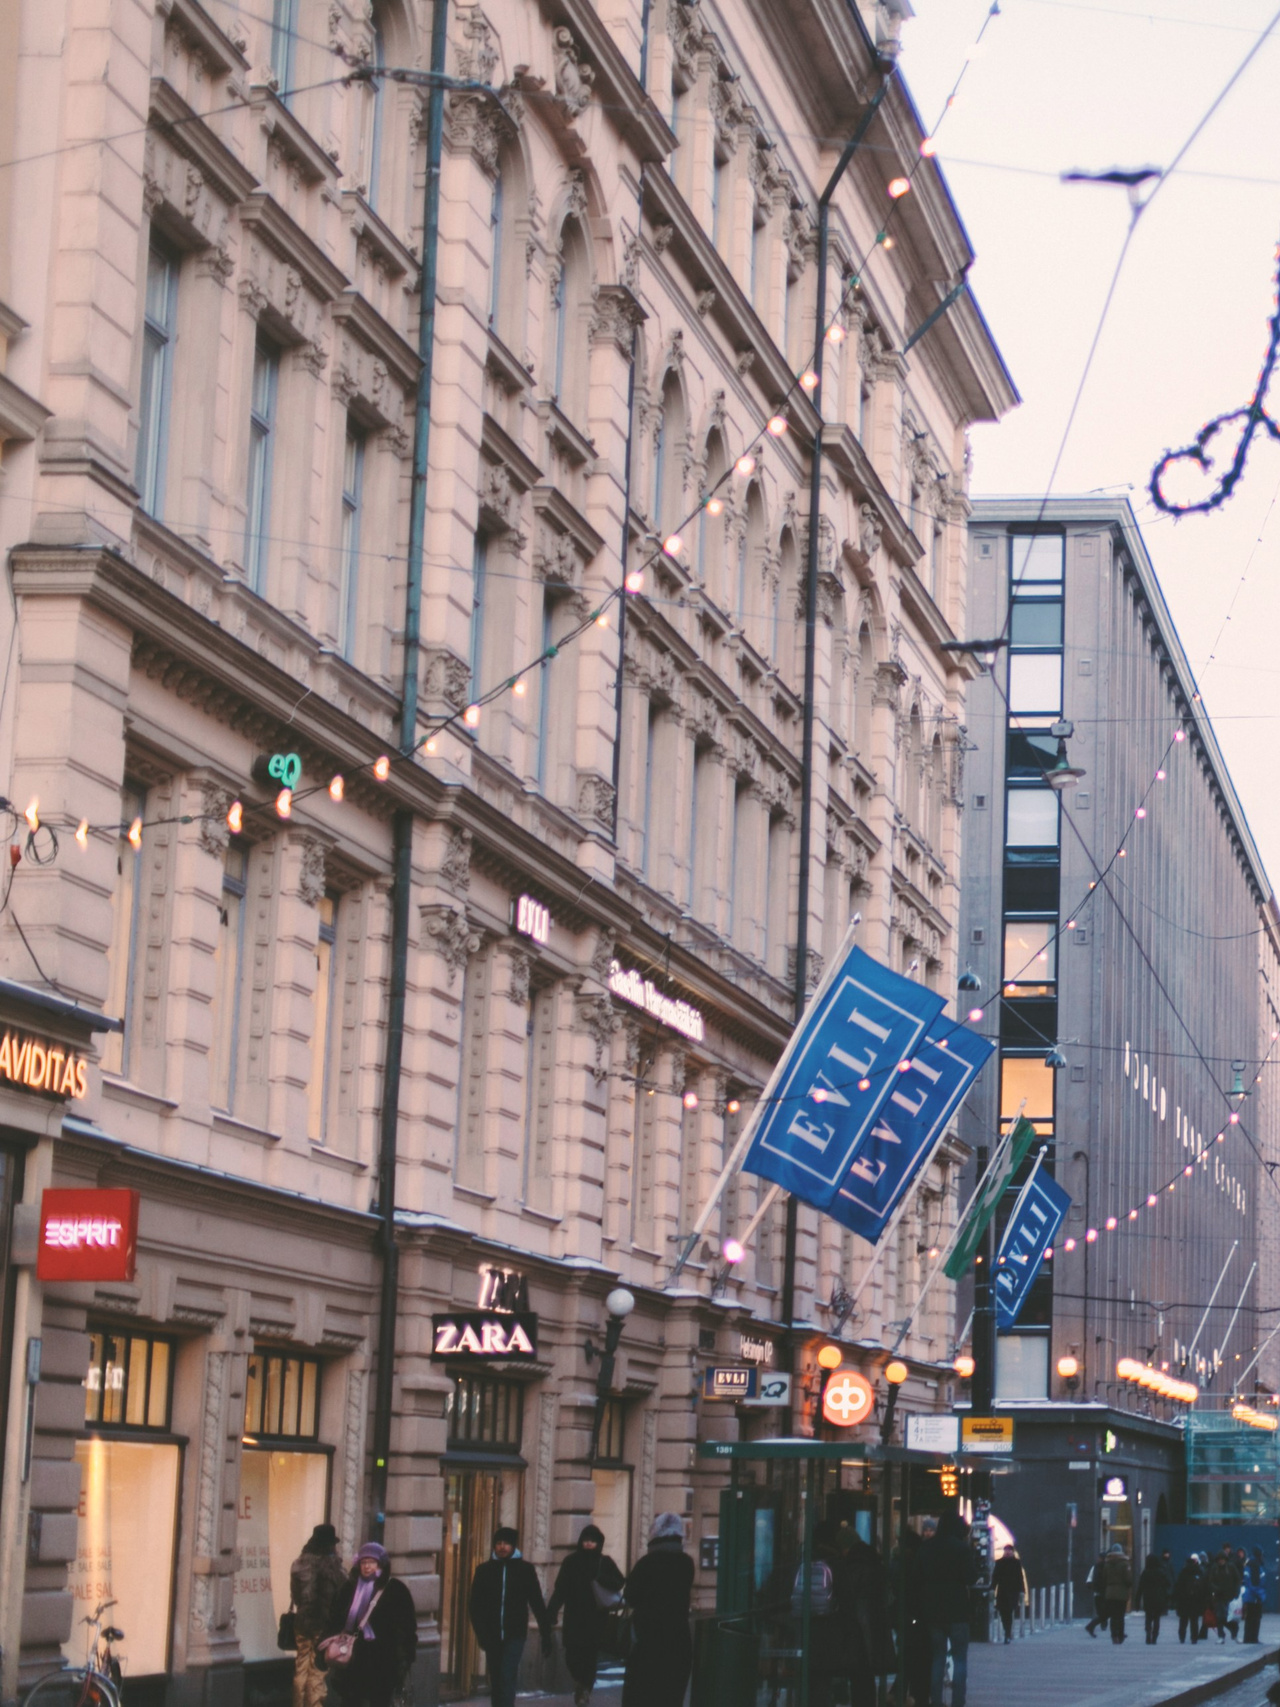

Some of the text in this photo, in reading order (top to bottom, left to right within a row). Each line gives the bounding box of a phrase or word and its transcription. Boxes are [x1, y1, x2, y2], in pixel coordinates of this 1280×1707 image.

[268, 753, 302, 791] eQ
[518, 894, 549, 944] EVLI
[786, 1007, 892, 1154] EVLI
[850, 1056, 943, 1188] EVLI
[45, 1222, 122, 1246] ESPRIT
[996, 1201, 1048, 1295] EVLI
[435, 1323, 534, 1354] ZARA
[717, 1372, 746, 1384] EVLI
